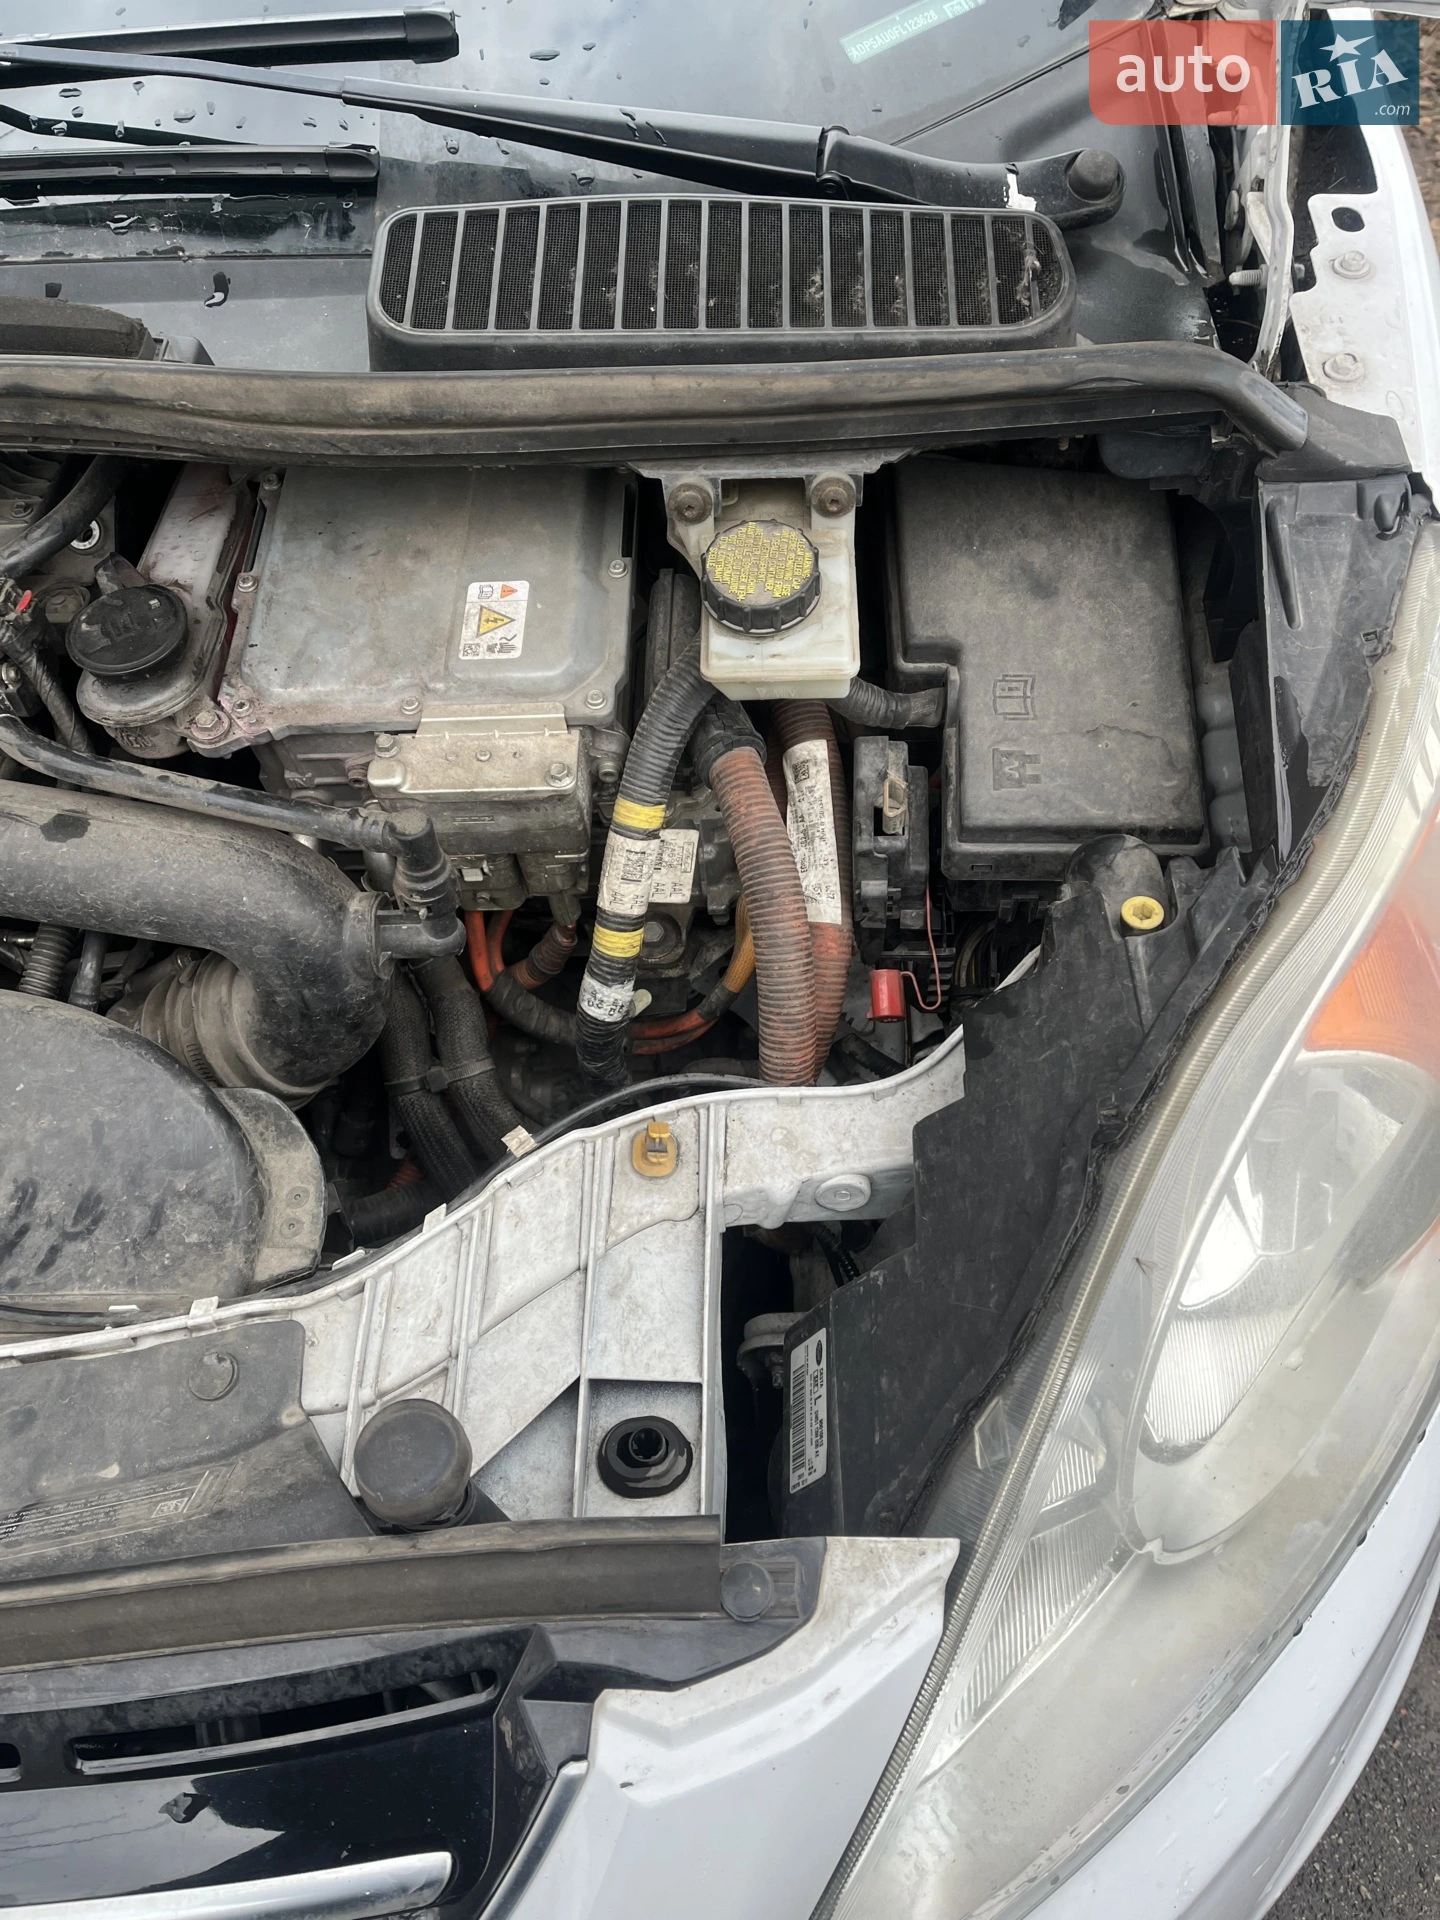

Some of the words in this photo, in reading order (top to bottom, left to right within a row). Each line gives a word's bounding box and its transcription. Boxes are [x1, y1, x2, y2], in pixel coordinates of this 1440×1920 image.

[746, 522, 756, 537] AVANT
[780, 529, 789, 541] ONLY
[728, 535, 737, 544] DOT
[797, 539, 806, 554] CLEAN
[770, 539, 779, 559] SEALED
[779, 544, 787, 554] DOT
[775, 564, 784, 578] FLUID
[794, 558, 803, 575] FILLER
[729, 572, 740, 594] LIQUIDE
[772, 582, 782, 598] FROM
[782, 585, 791, 596] USE
[791, 578, 801, 590] CAP
[650, 881, 667, 900] AAL
[669, 881, 684, 899] AAL
[608, 889, 625, 909] AAL
[630, 893, 646, 911] AAL
